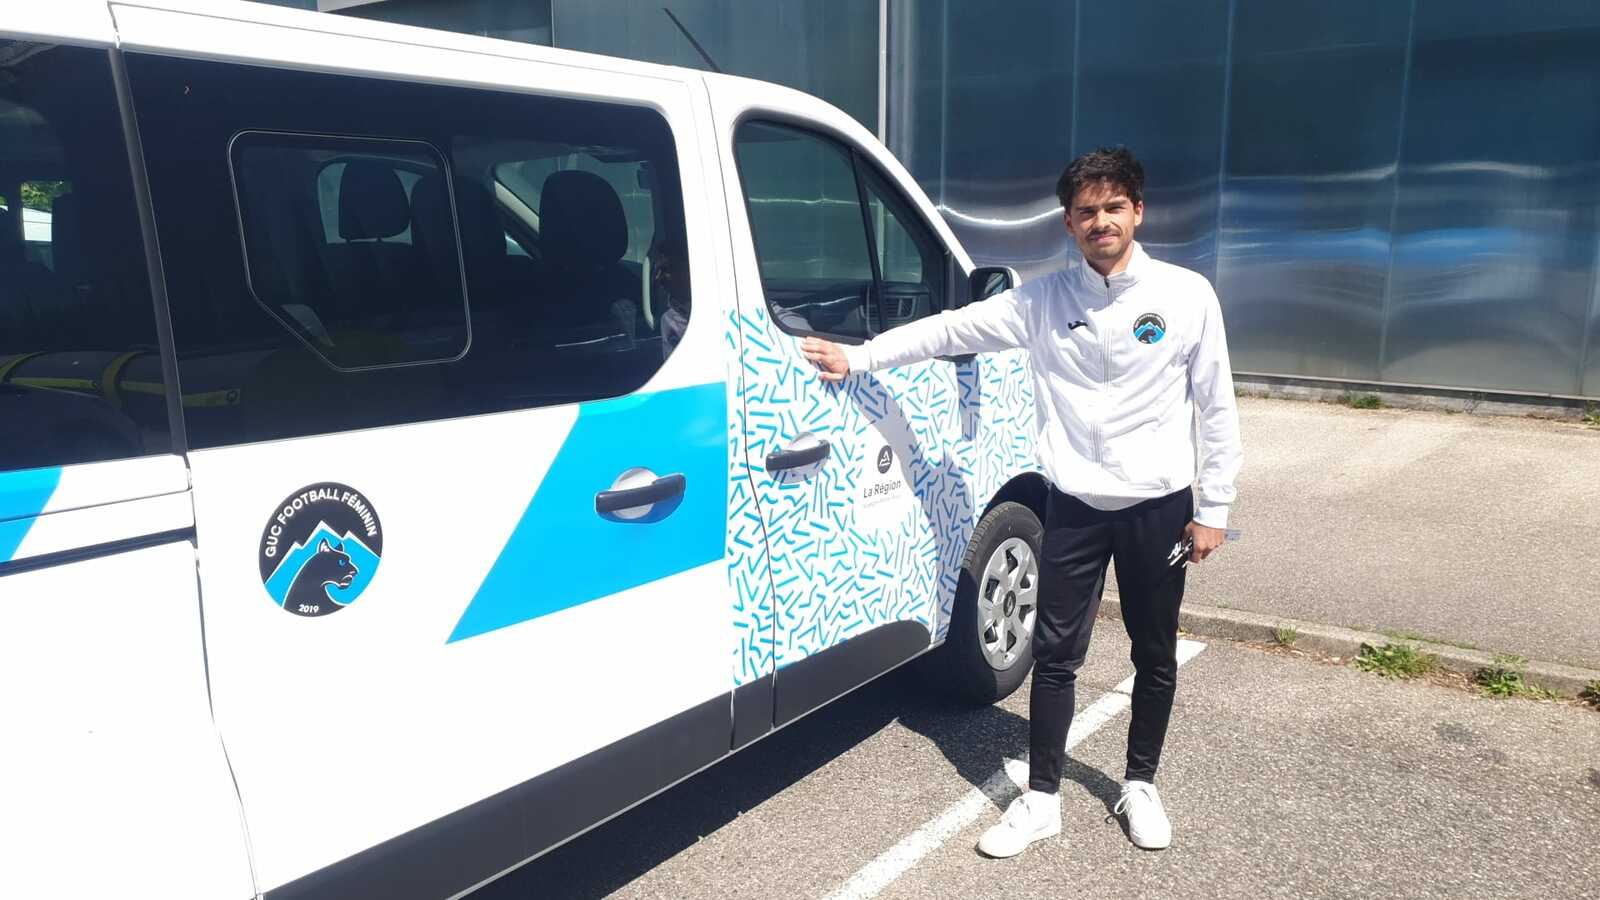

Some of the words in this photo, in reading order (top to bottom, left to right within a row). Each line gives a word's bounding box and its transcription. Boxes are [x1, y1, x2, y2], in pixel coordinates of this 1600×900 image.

[863, 487, 873, 498] La
[874, 479, 901, 495] Région
[265, 525, 282, 557] GUC
[277, 488, 340, 525] FOOTBALL
[341, 492, 377, 537] FÉMININ
[299, 604, 319, 613] 2019
